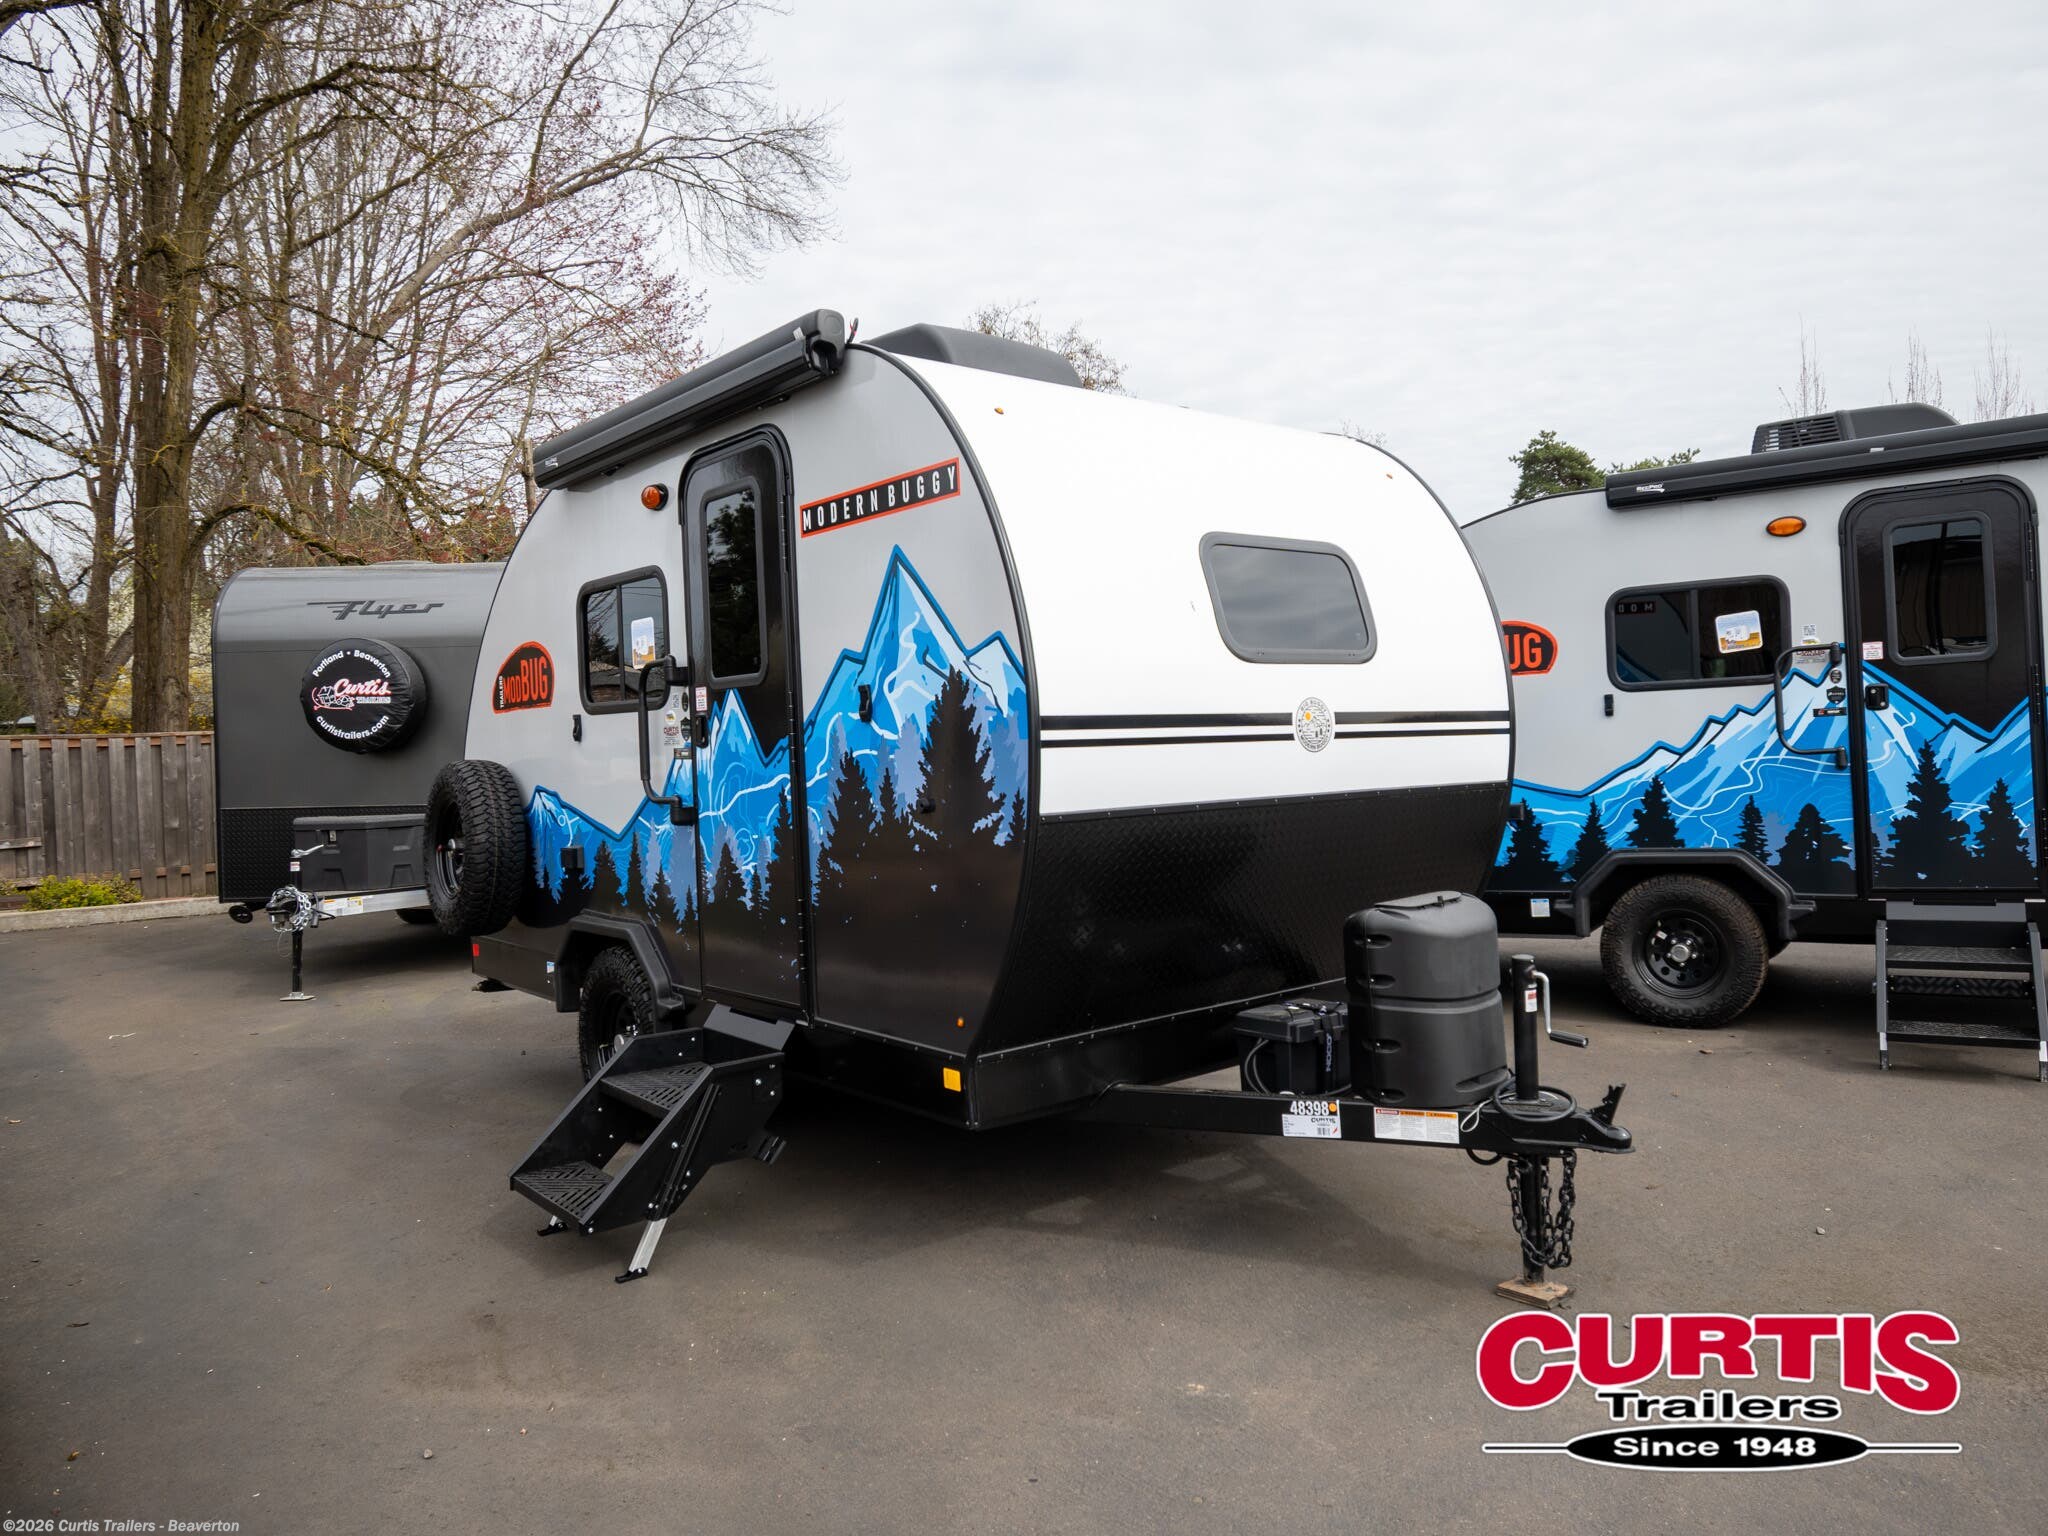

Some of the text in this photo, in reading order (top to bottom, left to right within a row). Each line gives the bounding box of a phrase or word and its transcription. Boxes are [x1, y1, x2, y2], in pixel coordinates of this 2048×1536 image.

[803, 465, 955, 531] MODERN BUGGY
[307, 600, 444, 620] Flyer
[1504, 632, 1542, 670] UG
[312, 650, 391, 678] Portland Beaverton
[333, 678, 392, 696] Curtis
[316, 715, 390, 739] curtistrailers.com
[1290, 1101, 1329, 1116] 48398
